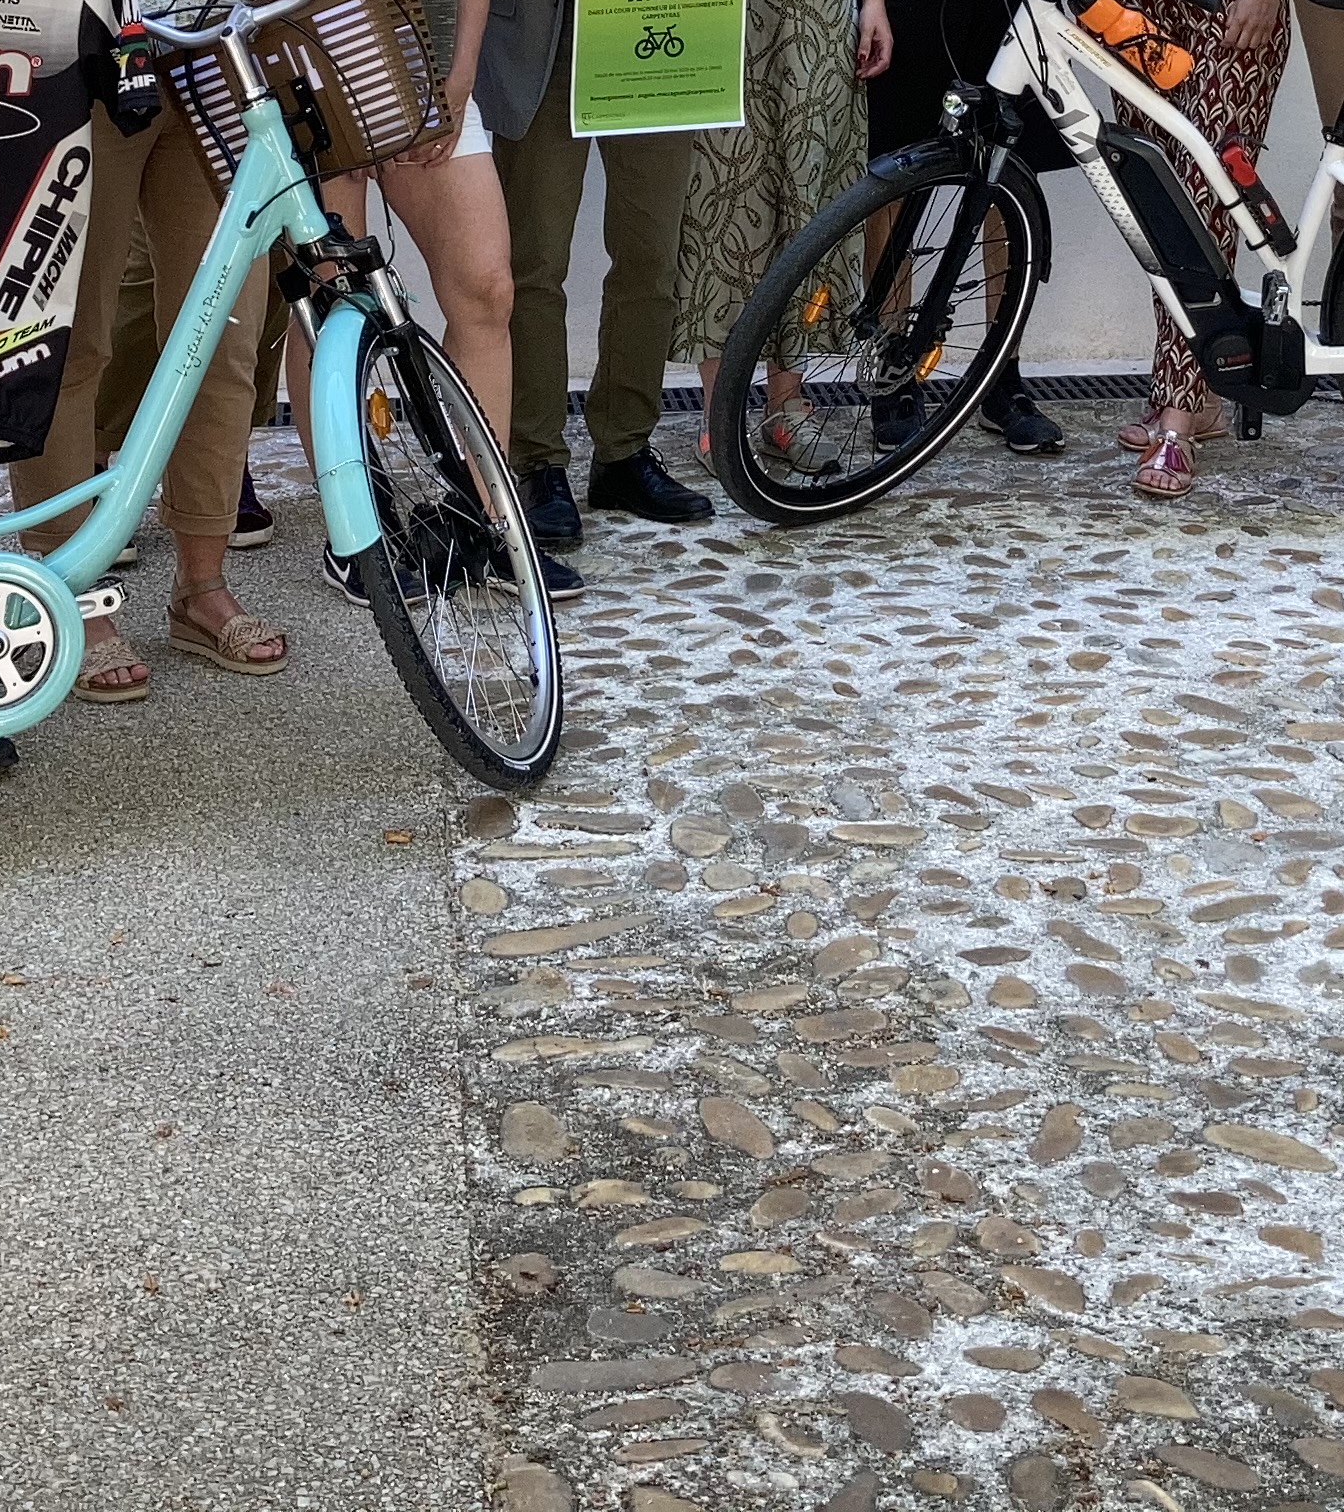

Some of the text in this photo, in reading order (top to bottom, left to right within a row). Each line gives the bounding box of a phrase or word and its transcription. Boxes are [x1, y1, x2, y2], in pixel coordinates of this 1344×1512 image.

[641, 11, 680, 20] CARPENTRAS
[36, 223, 79, 302] MACH
[12, 314, 57, 345] TEAM
